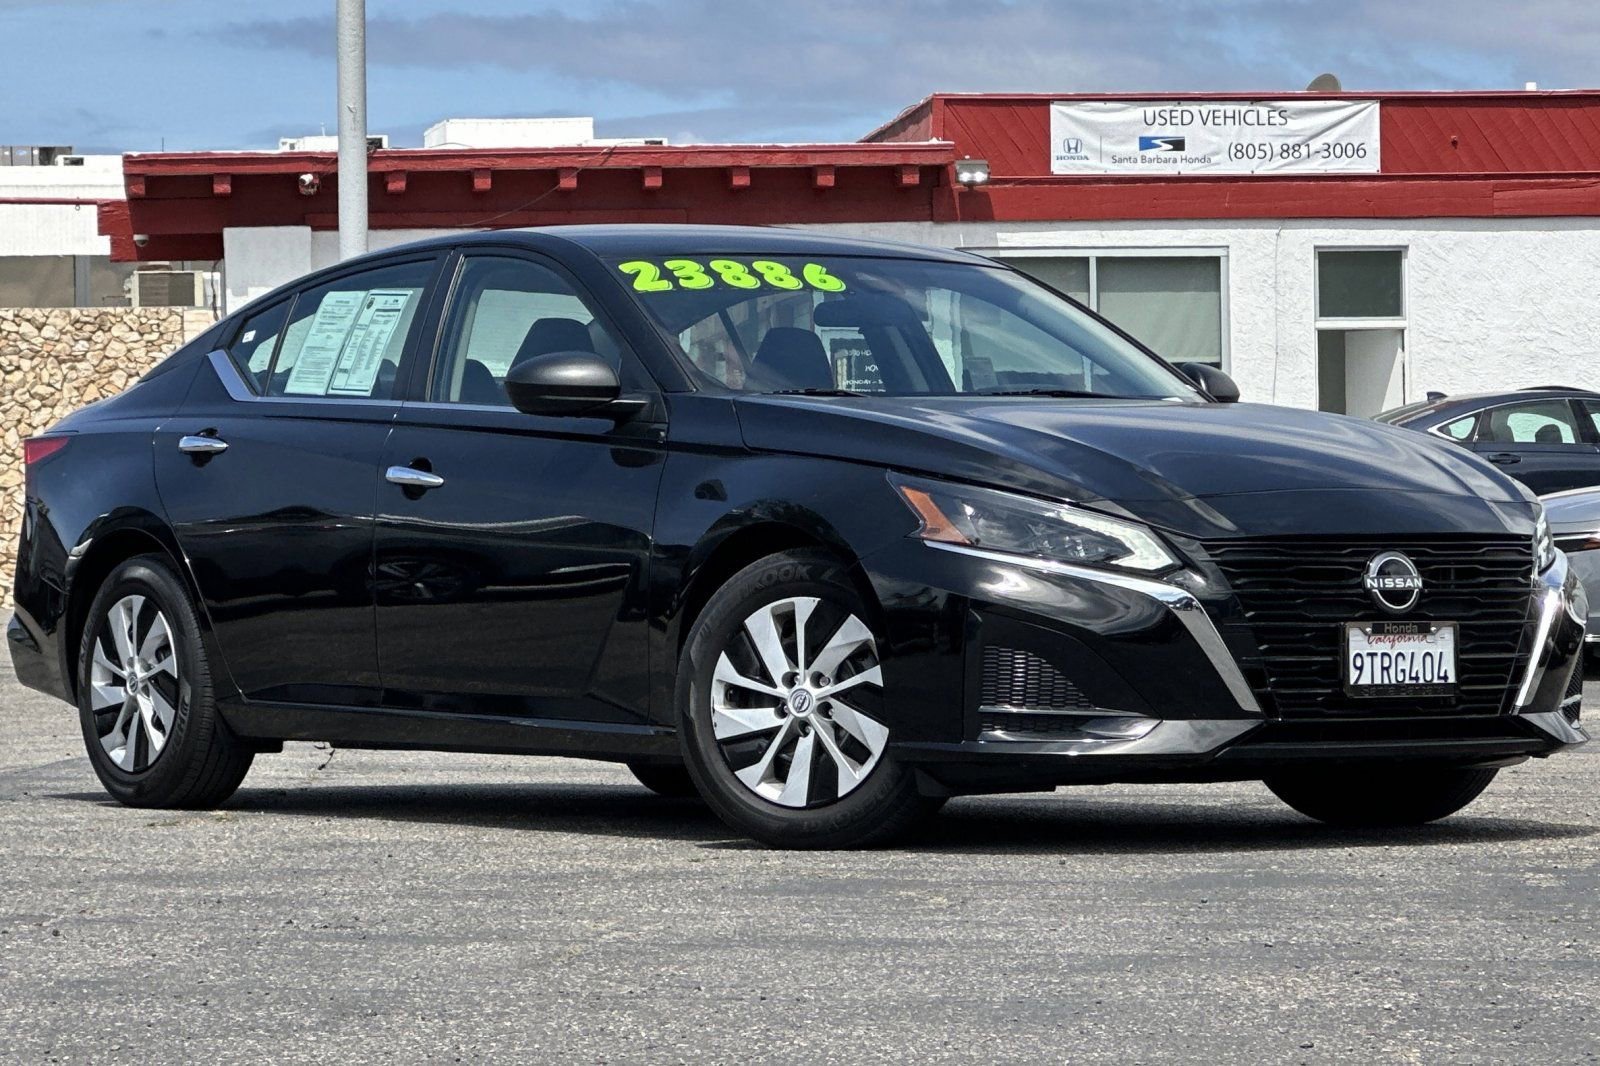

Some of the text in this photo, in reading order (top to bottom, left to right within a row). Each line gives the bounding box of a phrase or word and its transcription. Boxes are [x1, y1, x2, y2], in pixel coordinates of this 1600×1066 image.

[1143, 109, 1288, 126] USED VEHICLES
[1111, 155, 1212, 164] Santa Barbara Honda
[1228, 142, 1367, 162] (805) 881-3006
[618, 259, 847, 292] 23886
[1366, 578, 1422, 588] NISSAN
[1384, 623, 1418, 633] Honda
[1367, 634, 1432, 649] California
[1352, 651, 1449, 684] 9TRG404
